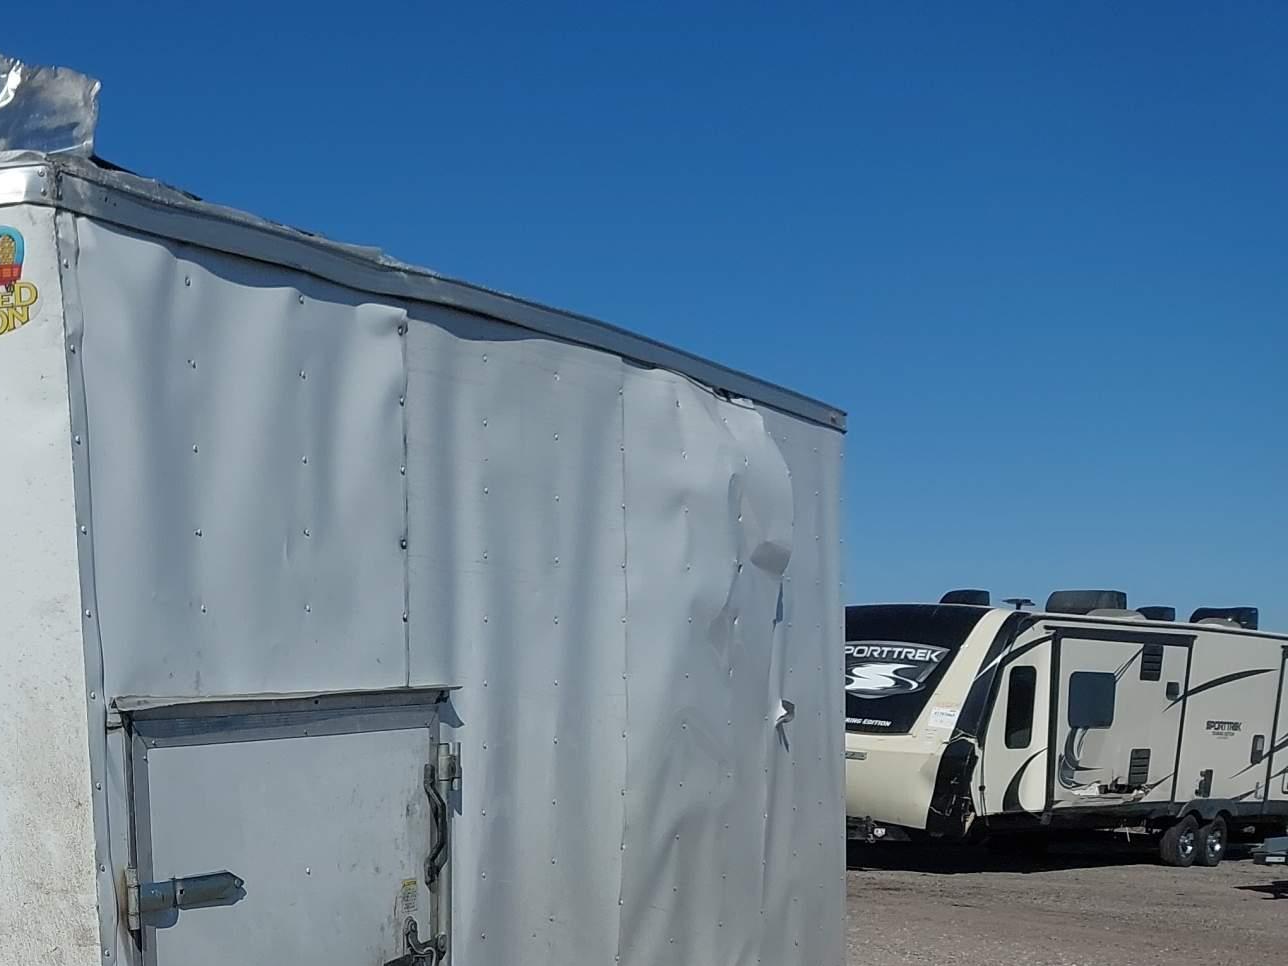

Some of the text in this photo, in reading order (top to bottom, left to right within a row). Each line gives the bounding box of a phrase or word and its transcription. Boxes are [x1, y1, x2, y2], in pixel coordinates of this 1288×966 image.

[845, 645, 943, 662] PORTTREK
[845, 717, 892, 727] RING EDITION
